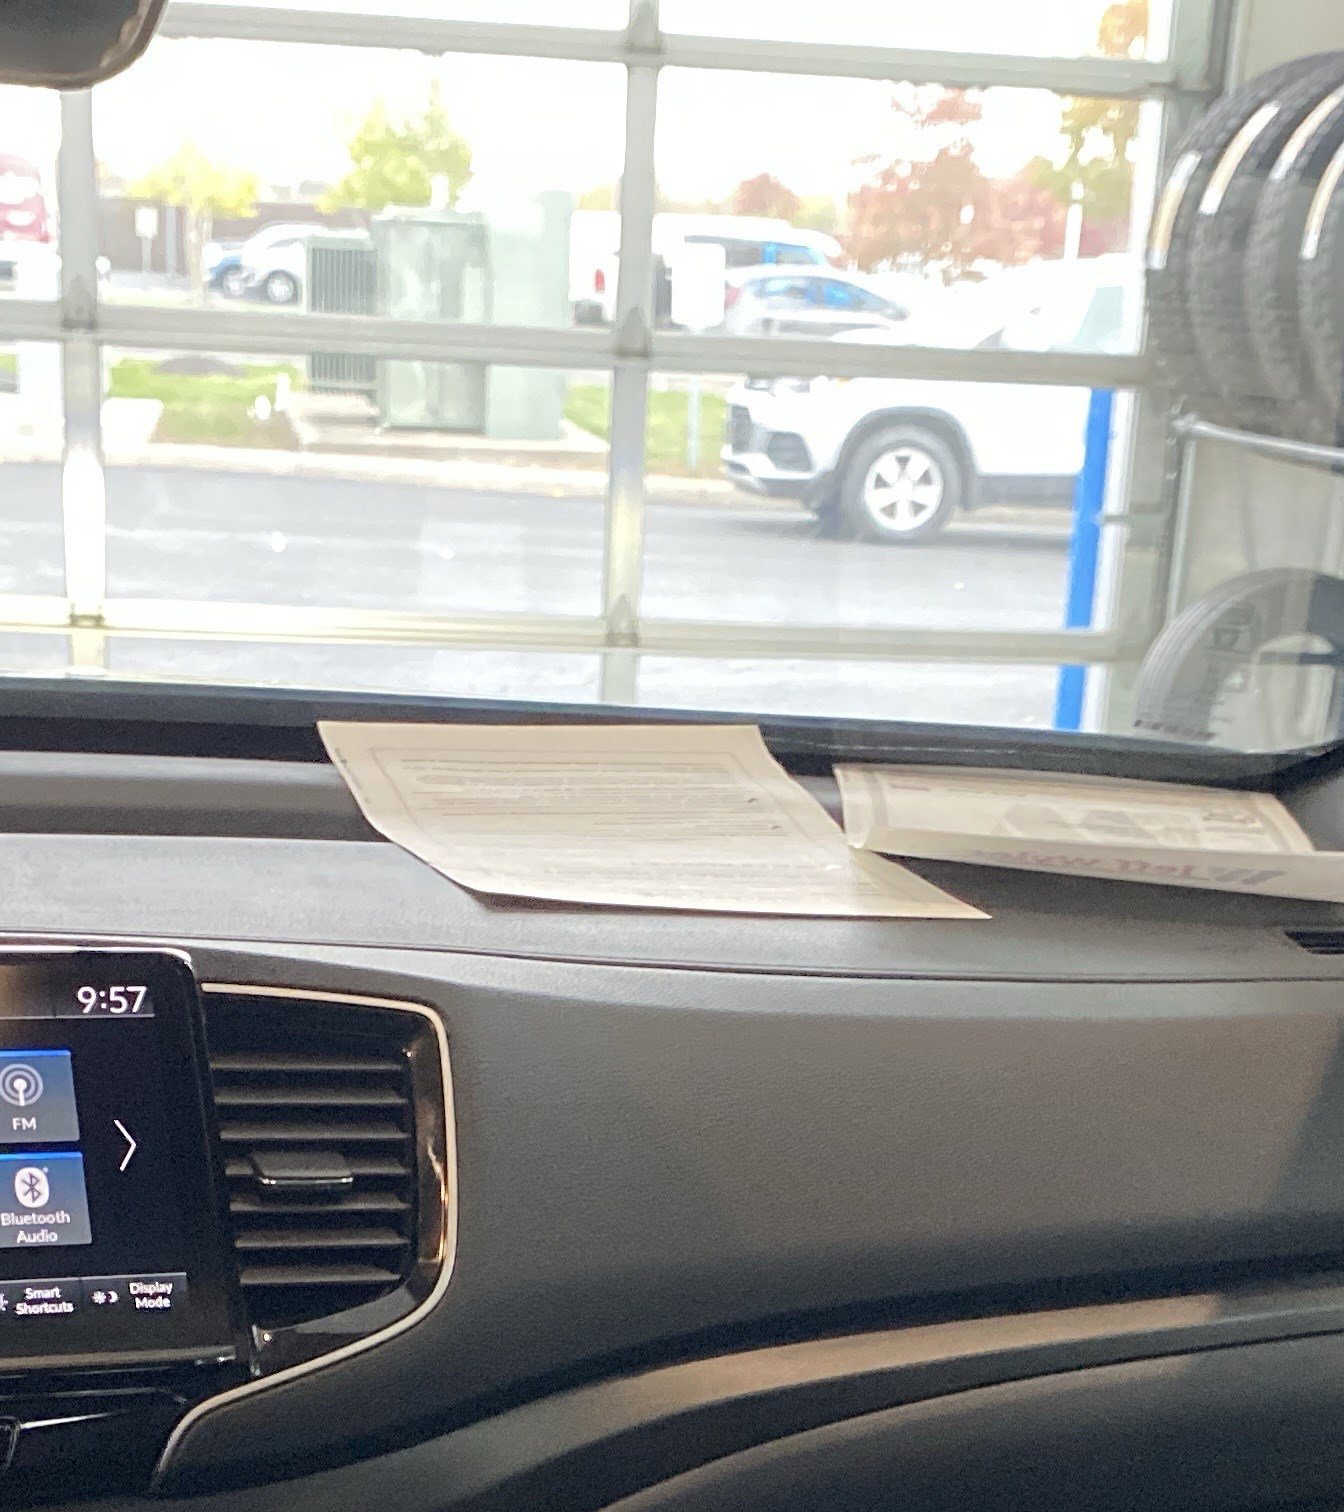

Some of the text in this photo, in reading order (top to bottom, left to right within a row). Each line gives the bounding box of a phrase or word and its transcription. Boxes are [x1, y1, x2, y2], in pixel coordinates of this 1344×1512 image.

[76, 985, 148, 1014] 9:57
[12, 1117, 37, 1132] FM
[0, 1210, 71, 1226] Bluetooth
[16, 1228, 59, 1244] Audio
[25, 1286, 61, 1300] Smart
[129, 1281, 174, 1298] Display
[16, 1299, 75, 1316] Shortcuts
[135, 1295, 172, 1311] Mode
